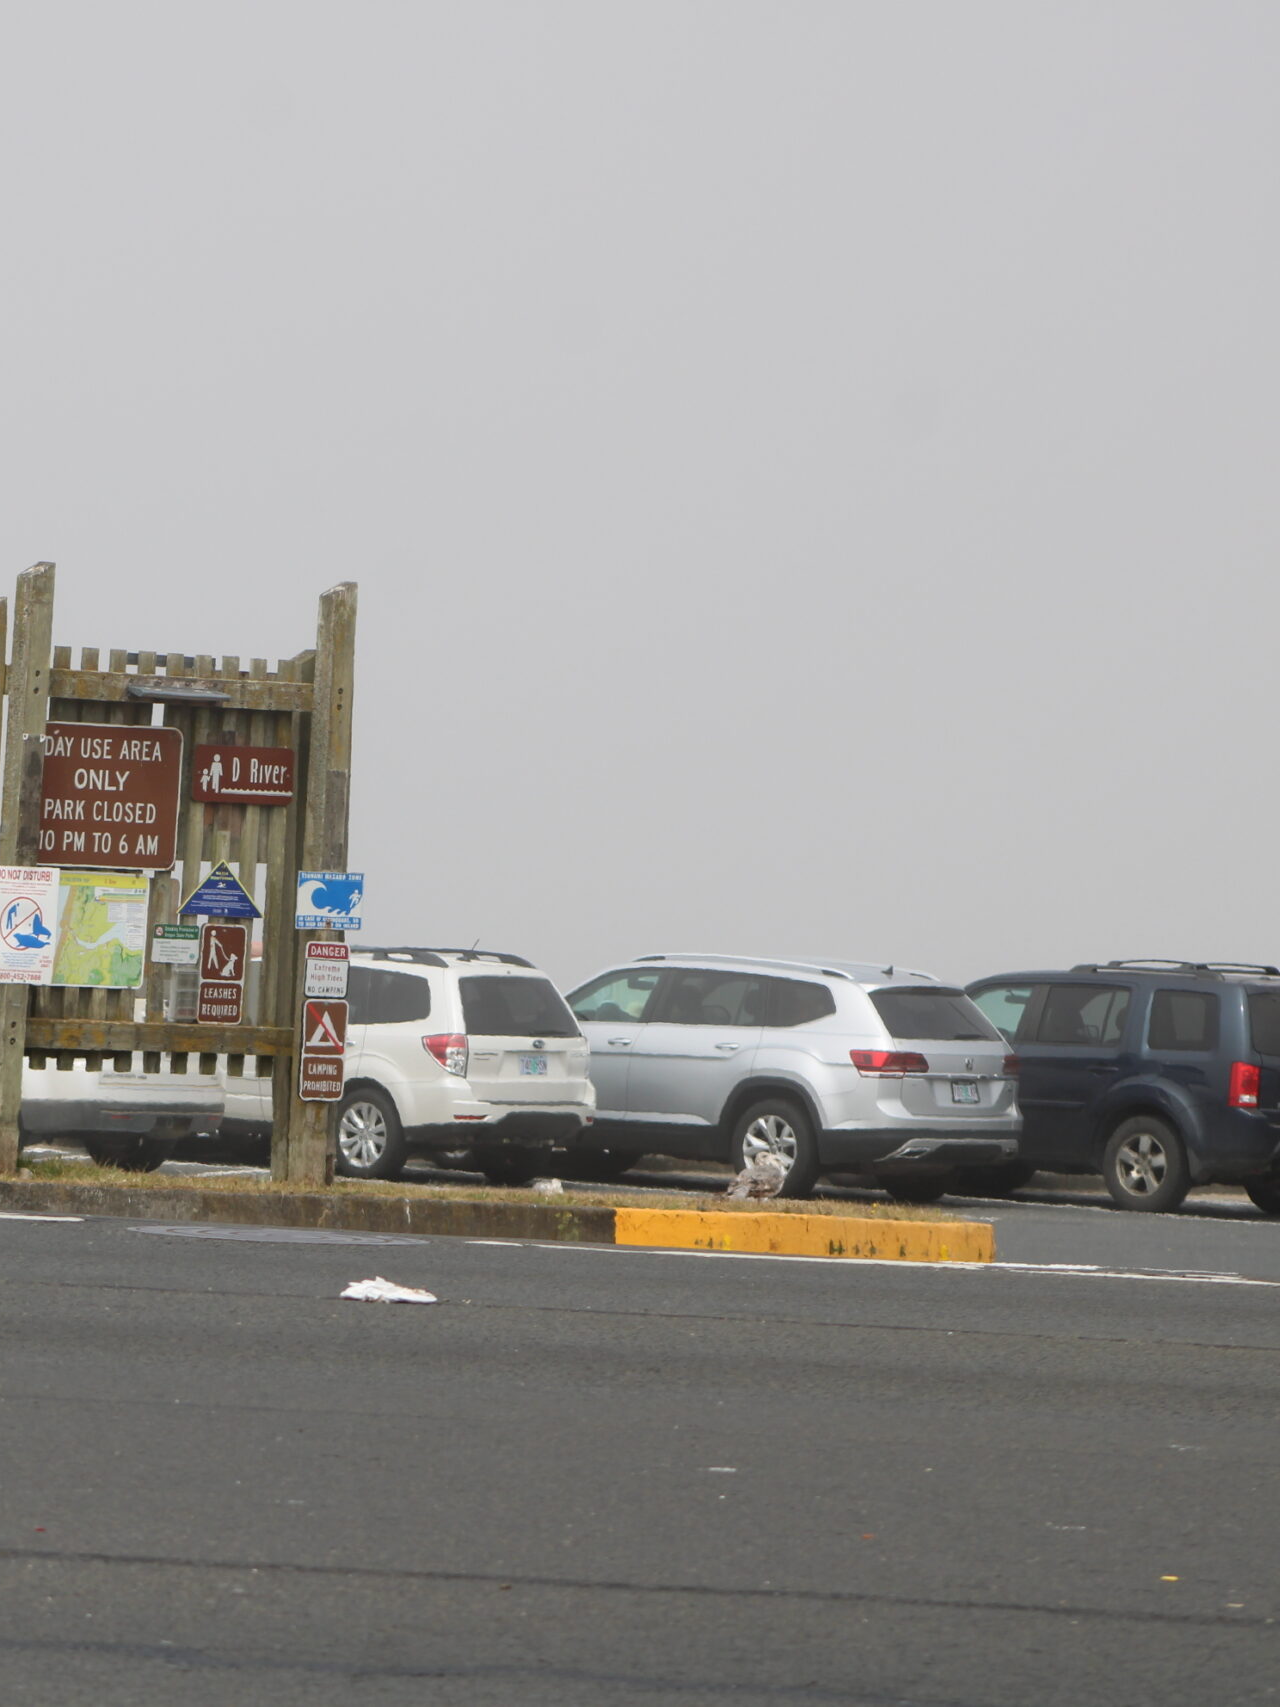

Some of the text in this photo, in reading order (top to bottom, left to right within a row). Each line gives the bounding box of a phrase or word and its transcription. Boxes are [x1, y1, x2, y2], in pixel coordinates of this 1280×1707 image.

[44, 735, 162, 762] DAY USE AREA
[232, 757, 287, 784] D River
[74, 768, 130, 791] ONLY
[44, 798, 156, 824] PARK CLOSED
[39, 830, 159, 856] 10 PM TO 6 AM
[8, 869, 21, 880] NOT
[23, 870, 53, 882] DISTURB!
[310, 946, 346, 957] DANGER
[314, 963, 341, 972] Extreme
[310, 972, 342, 982] High Tides
[204, 987, 237, 1000] LEASHES
[307, 985, 344, 994] NO CAMPING
[201, 1003, 238, 1017] REQUIRED
[308, 1063, 337, 1075] CAMPING
[303, 1081, 341, 1093] PROHIBITED
